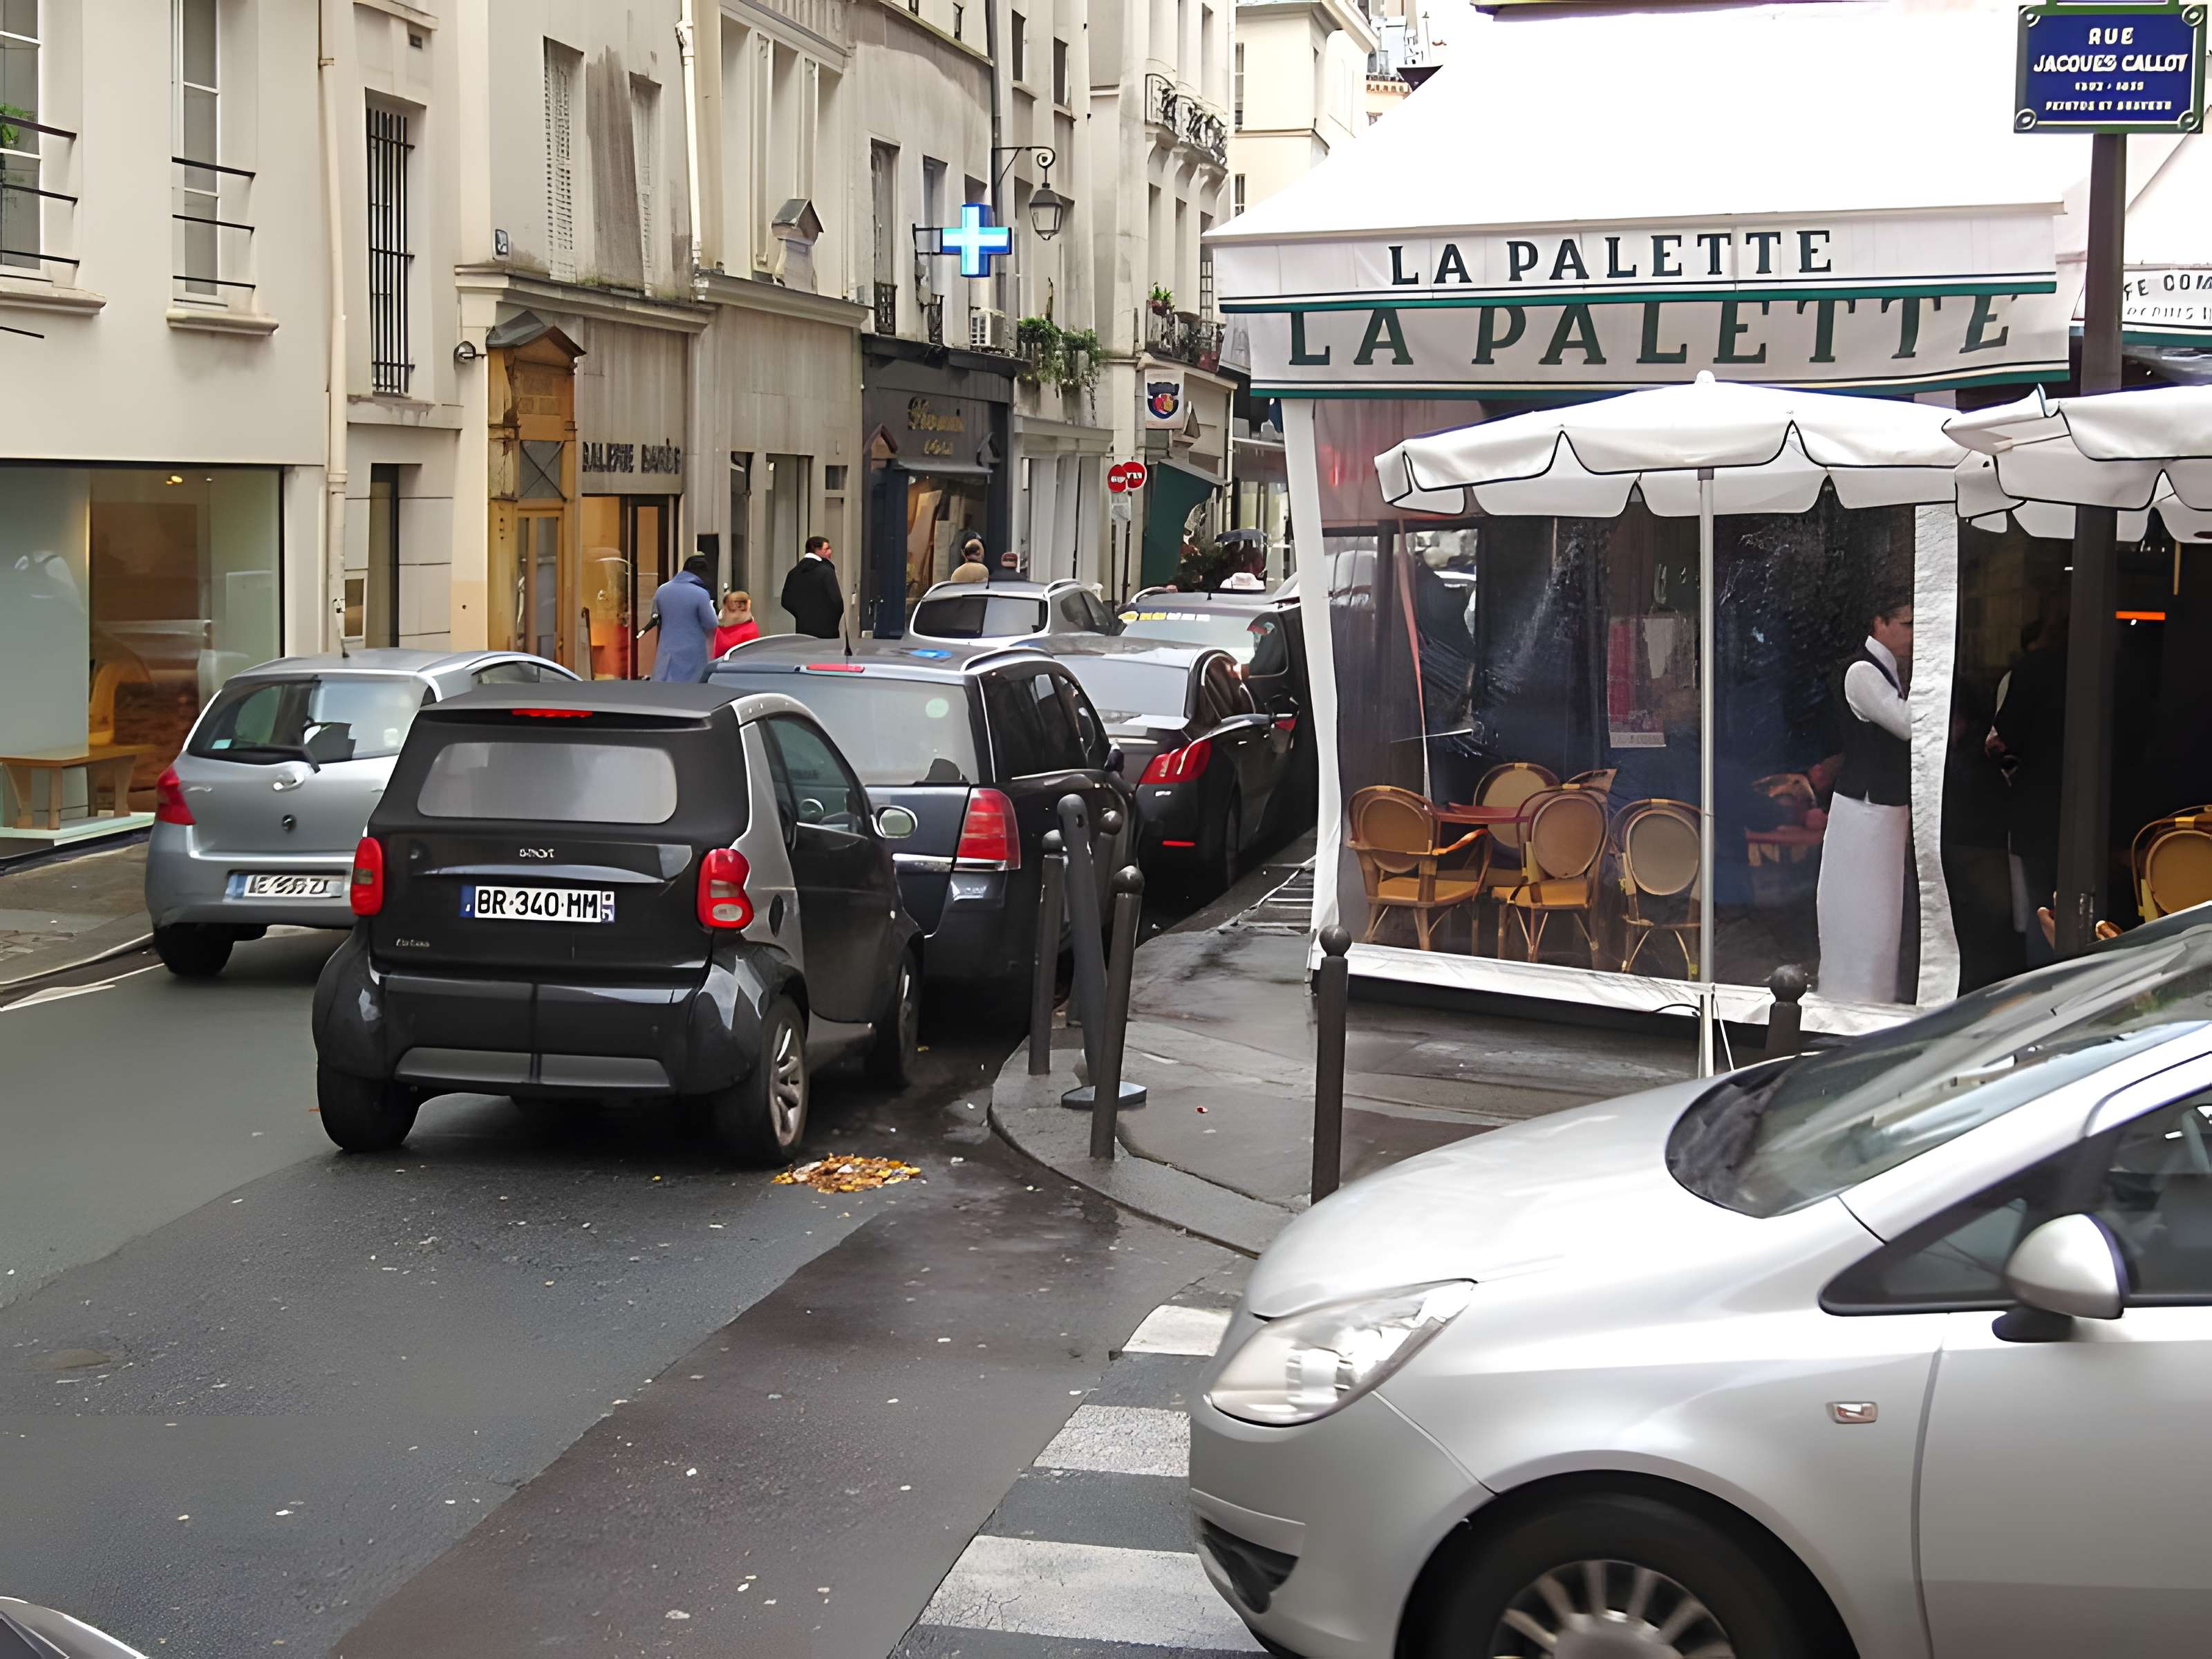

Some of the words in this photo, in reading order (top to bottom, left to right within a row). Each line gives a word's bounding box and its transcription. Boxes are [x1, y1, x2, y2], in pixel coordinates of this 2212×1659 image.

[2088, 27, 2134, 45] RUE
[2033, 55, 2117, 72] JACQUES
[2121, 54, 2188, 72] CALLOT
[1388, 243, 1472, 285] LA
[1506, 229, 1832, 282] PALETTE
[1288, 308, 1414, 366] LA
[1471, 293, 2018, 365] PALETTE
